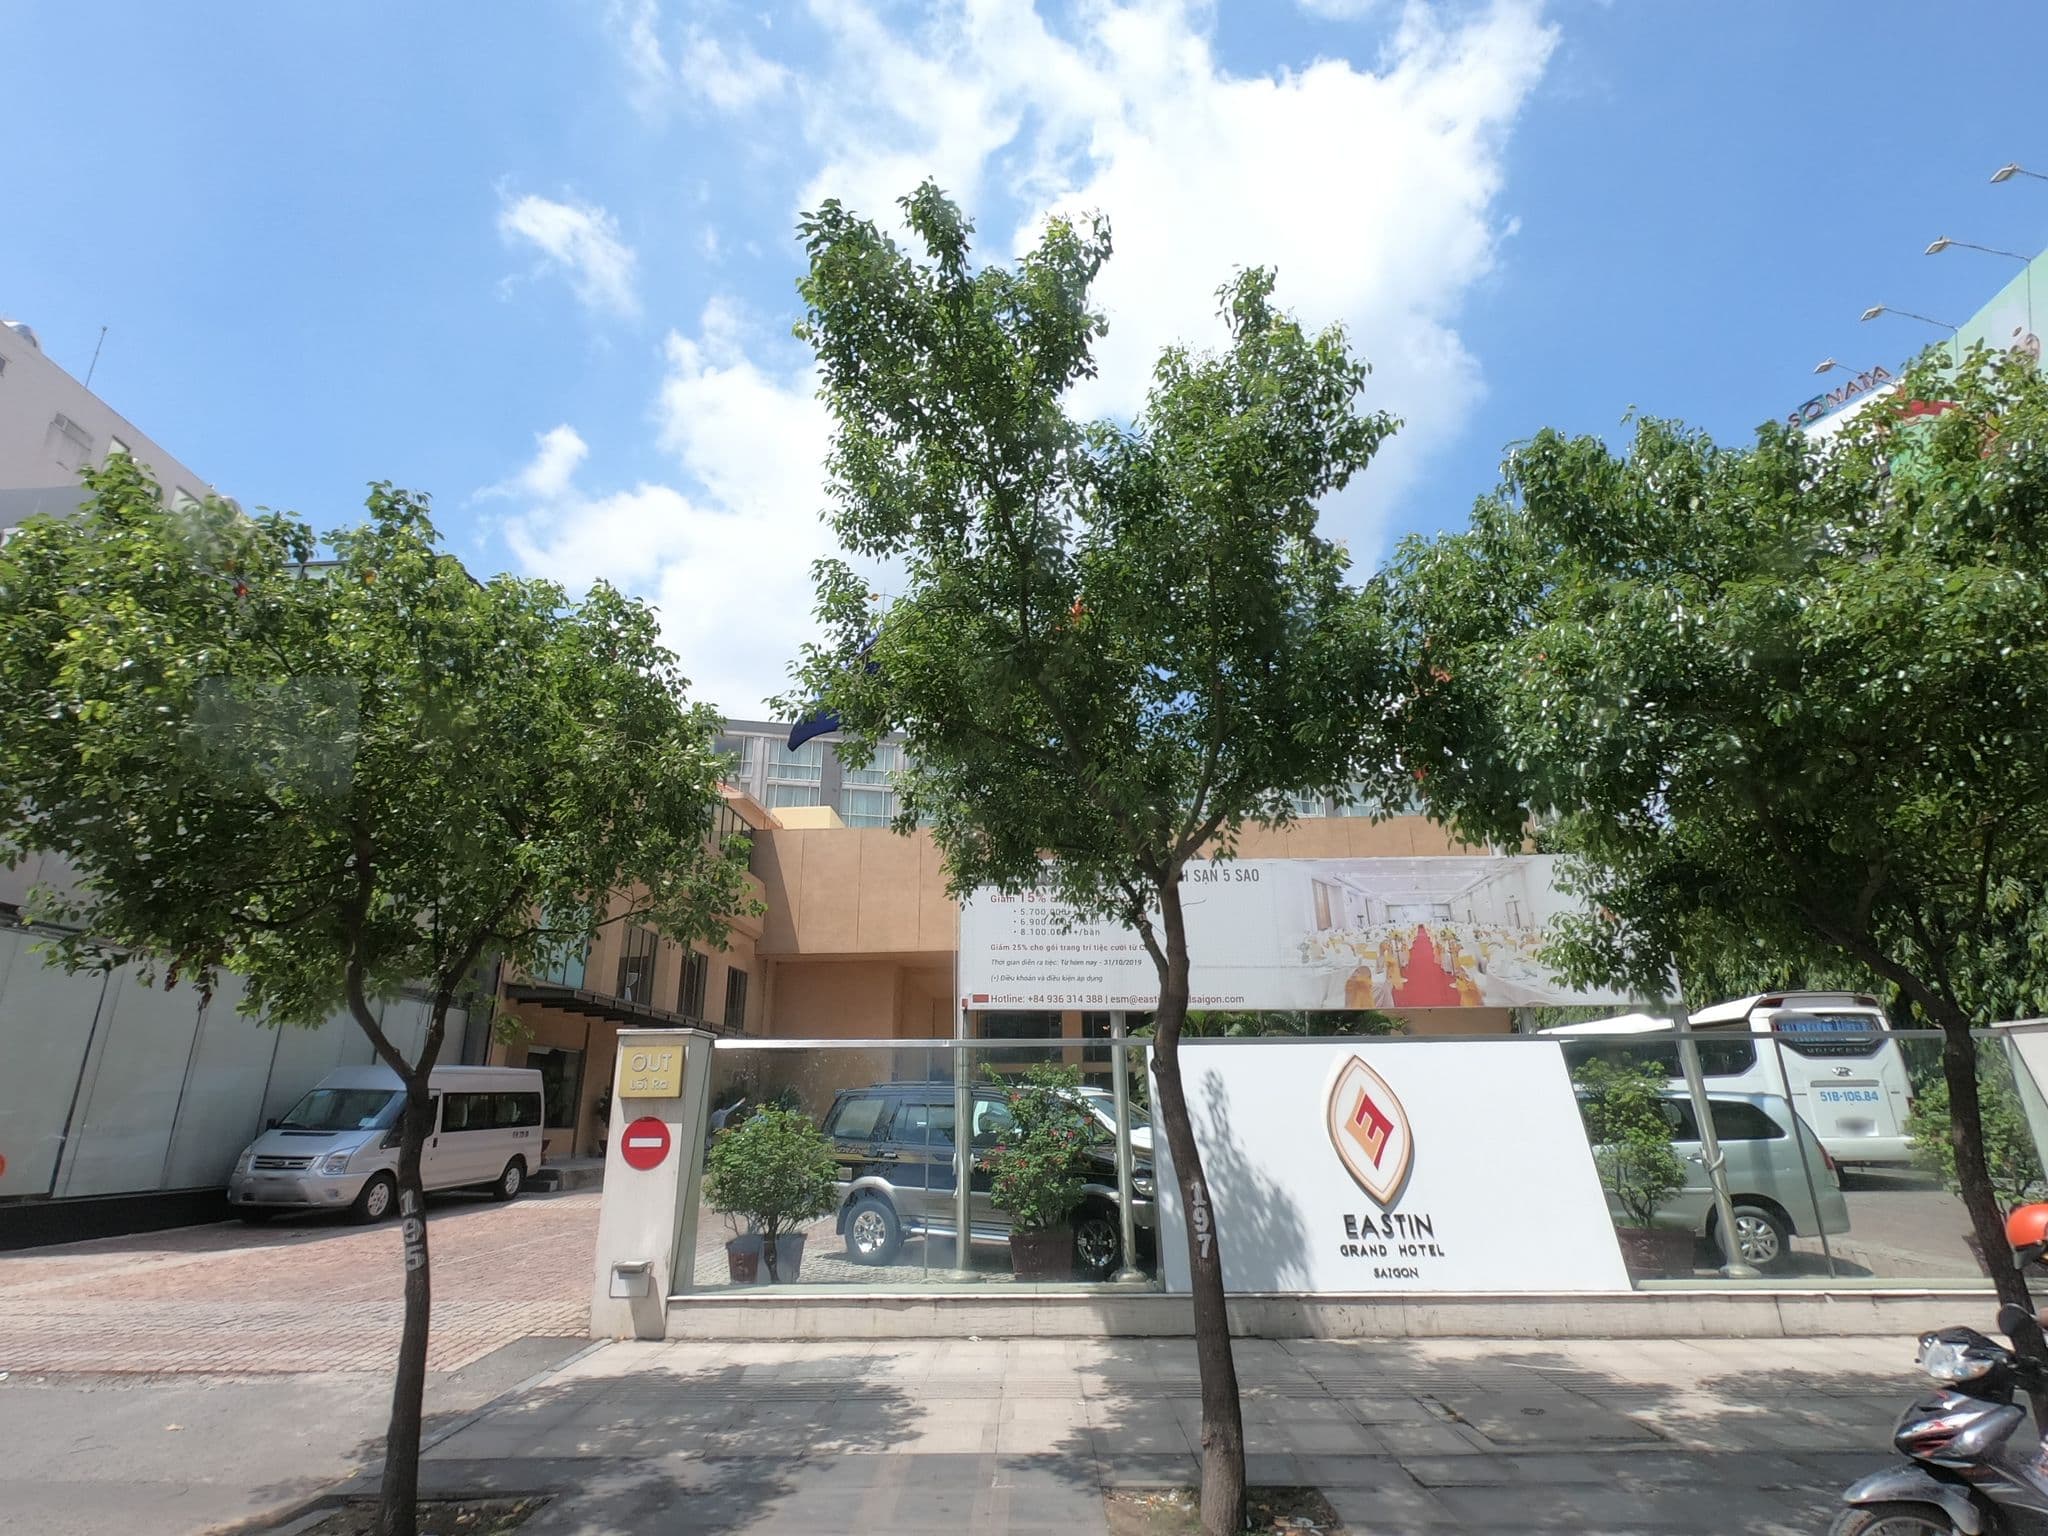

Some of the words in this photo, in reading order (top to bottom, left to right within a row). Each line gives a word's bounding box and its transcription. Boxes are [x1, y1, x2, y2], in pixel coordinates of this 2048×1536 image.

[1788, 366, 1891, 428] SONATA
[1223, 868, 1230, 882] 5
[1235, 868, 1260, 882] SAO
[1013, 943, 1028, 951] 25%
[1030, 943, 1044, 951] cho
[1046, 943, 1059, 952] gói
[1060, 944, 1080, 952] trang
[1085, 960, 1098, 968] nay
[1103, 958, 1142, 967] 31/10/2019
[991, 993, 1025, 1003] Hotline:
[1028, 994, 1044, 1003] +84
[1047, 994, 1064, 1003] 936
[1066, 994, 1083, 1003] 314
[1086, 994, 1103, 1003] 388
[631, 1053, 672, 1072] OUT
[652, 1080, 669, 1090] Ra
[1820, 1091, 1879, 1102] 51B-106.84
[1191, 1181, 1211, 1259] 197
[400, 1189, 425, 1271] 195
[1343, 1214, 1435, 1240] EASTIN
[1340, 1244, 1388, 1257] GRAND
[1399, 1244, 1445, 1257] HOTEL
[1373, 1268, 1419, 1279] SAIGON
